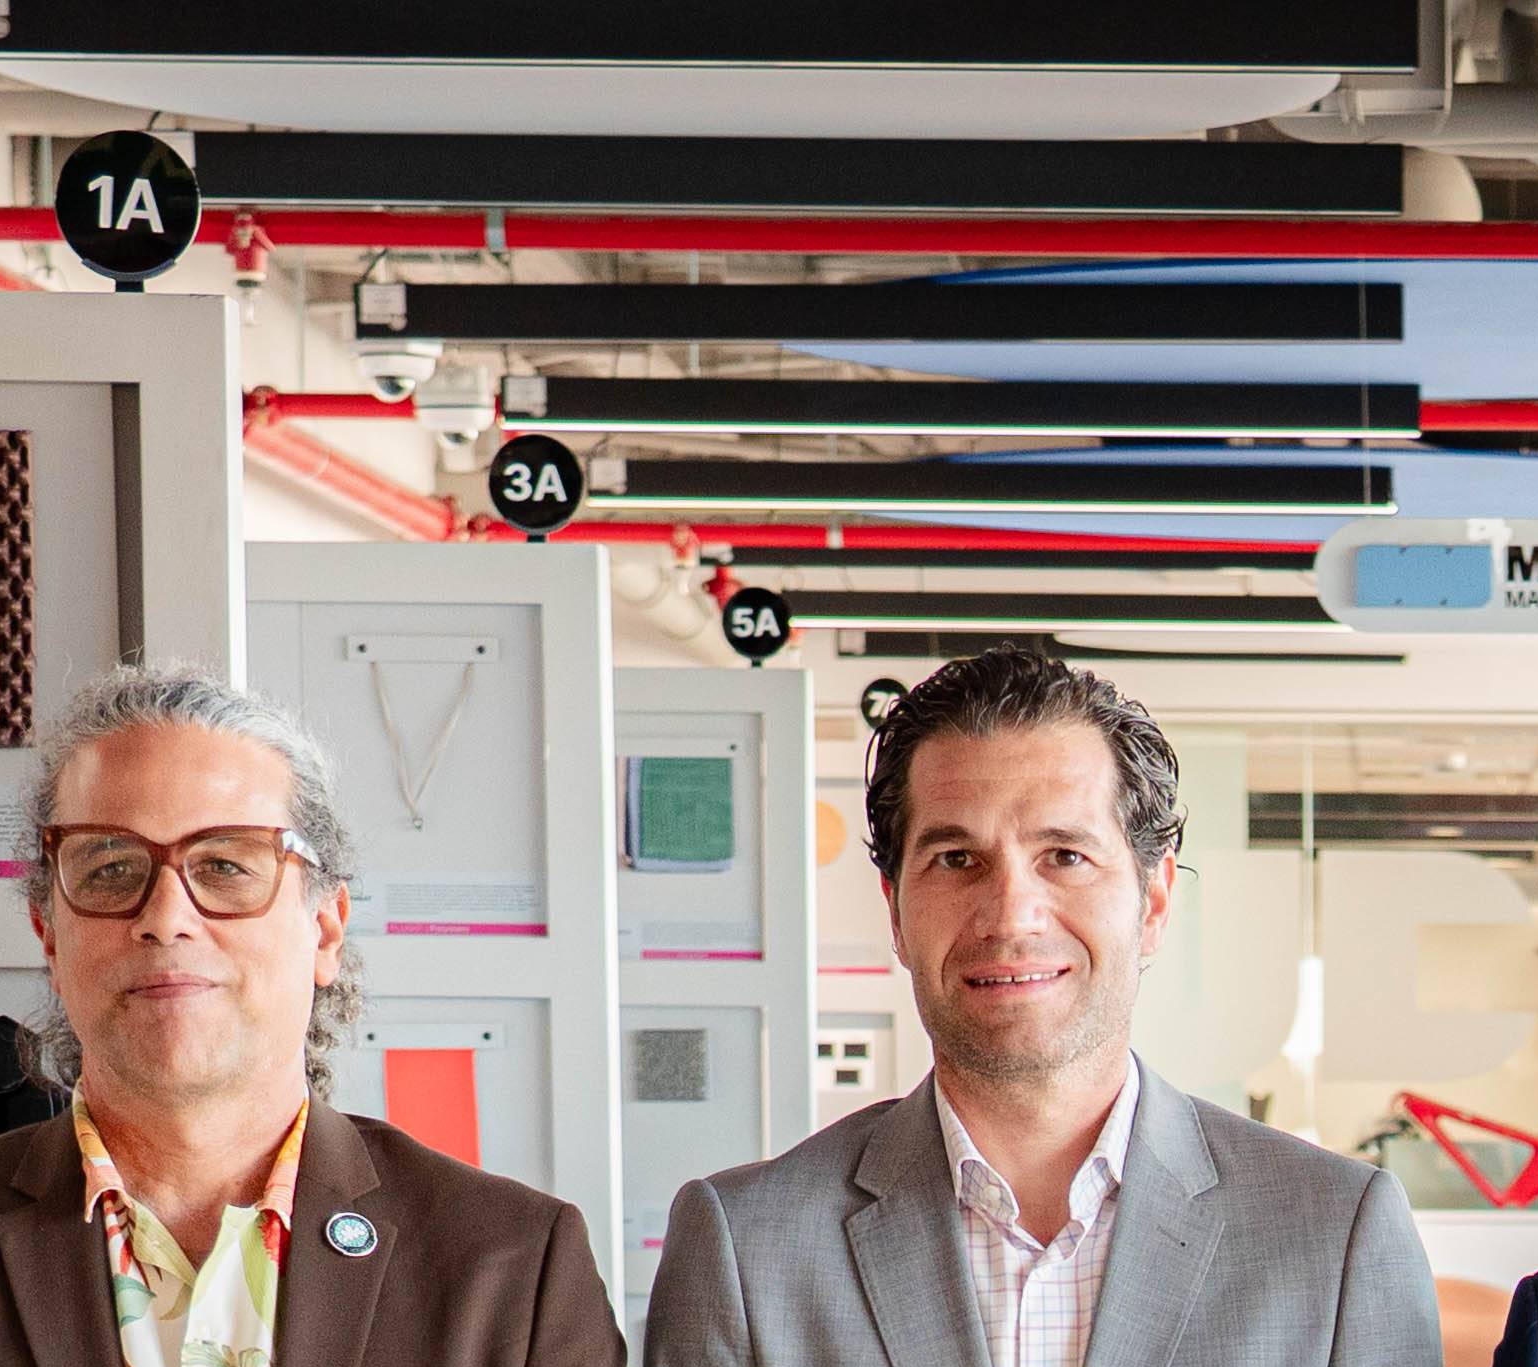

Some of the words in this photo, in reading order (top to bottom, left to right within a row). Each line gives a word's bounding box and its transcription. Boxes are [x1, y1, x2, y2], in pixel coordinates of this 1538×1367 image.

[88, 176, 165, 234] 1A
[502, 464, 568, 504] 3A
[732, 608, 781, 639] 5A
